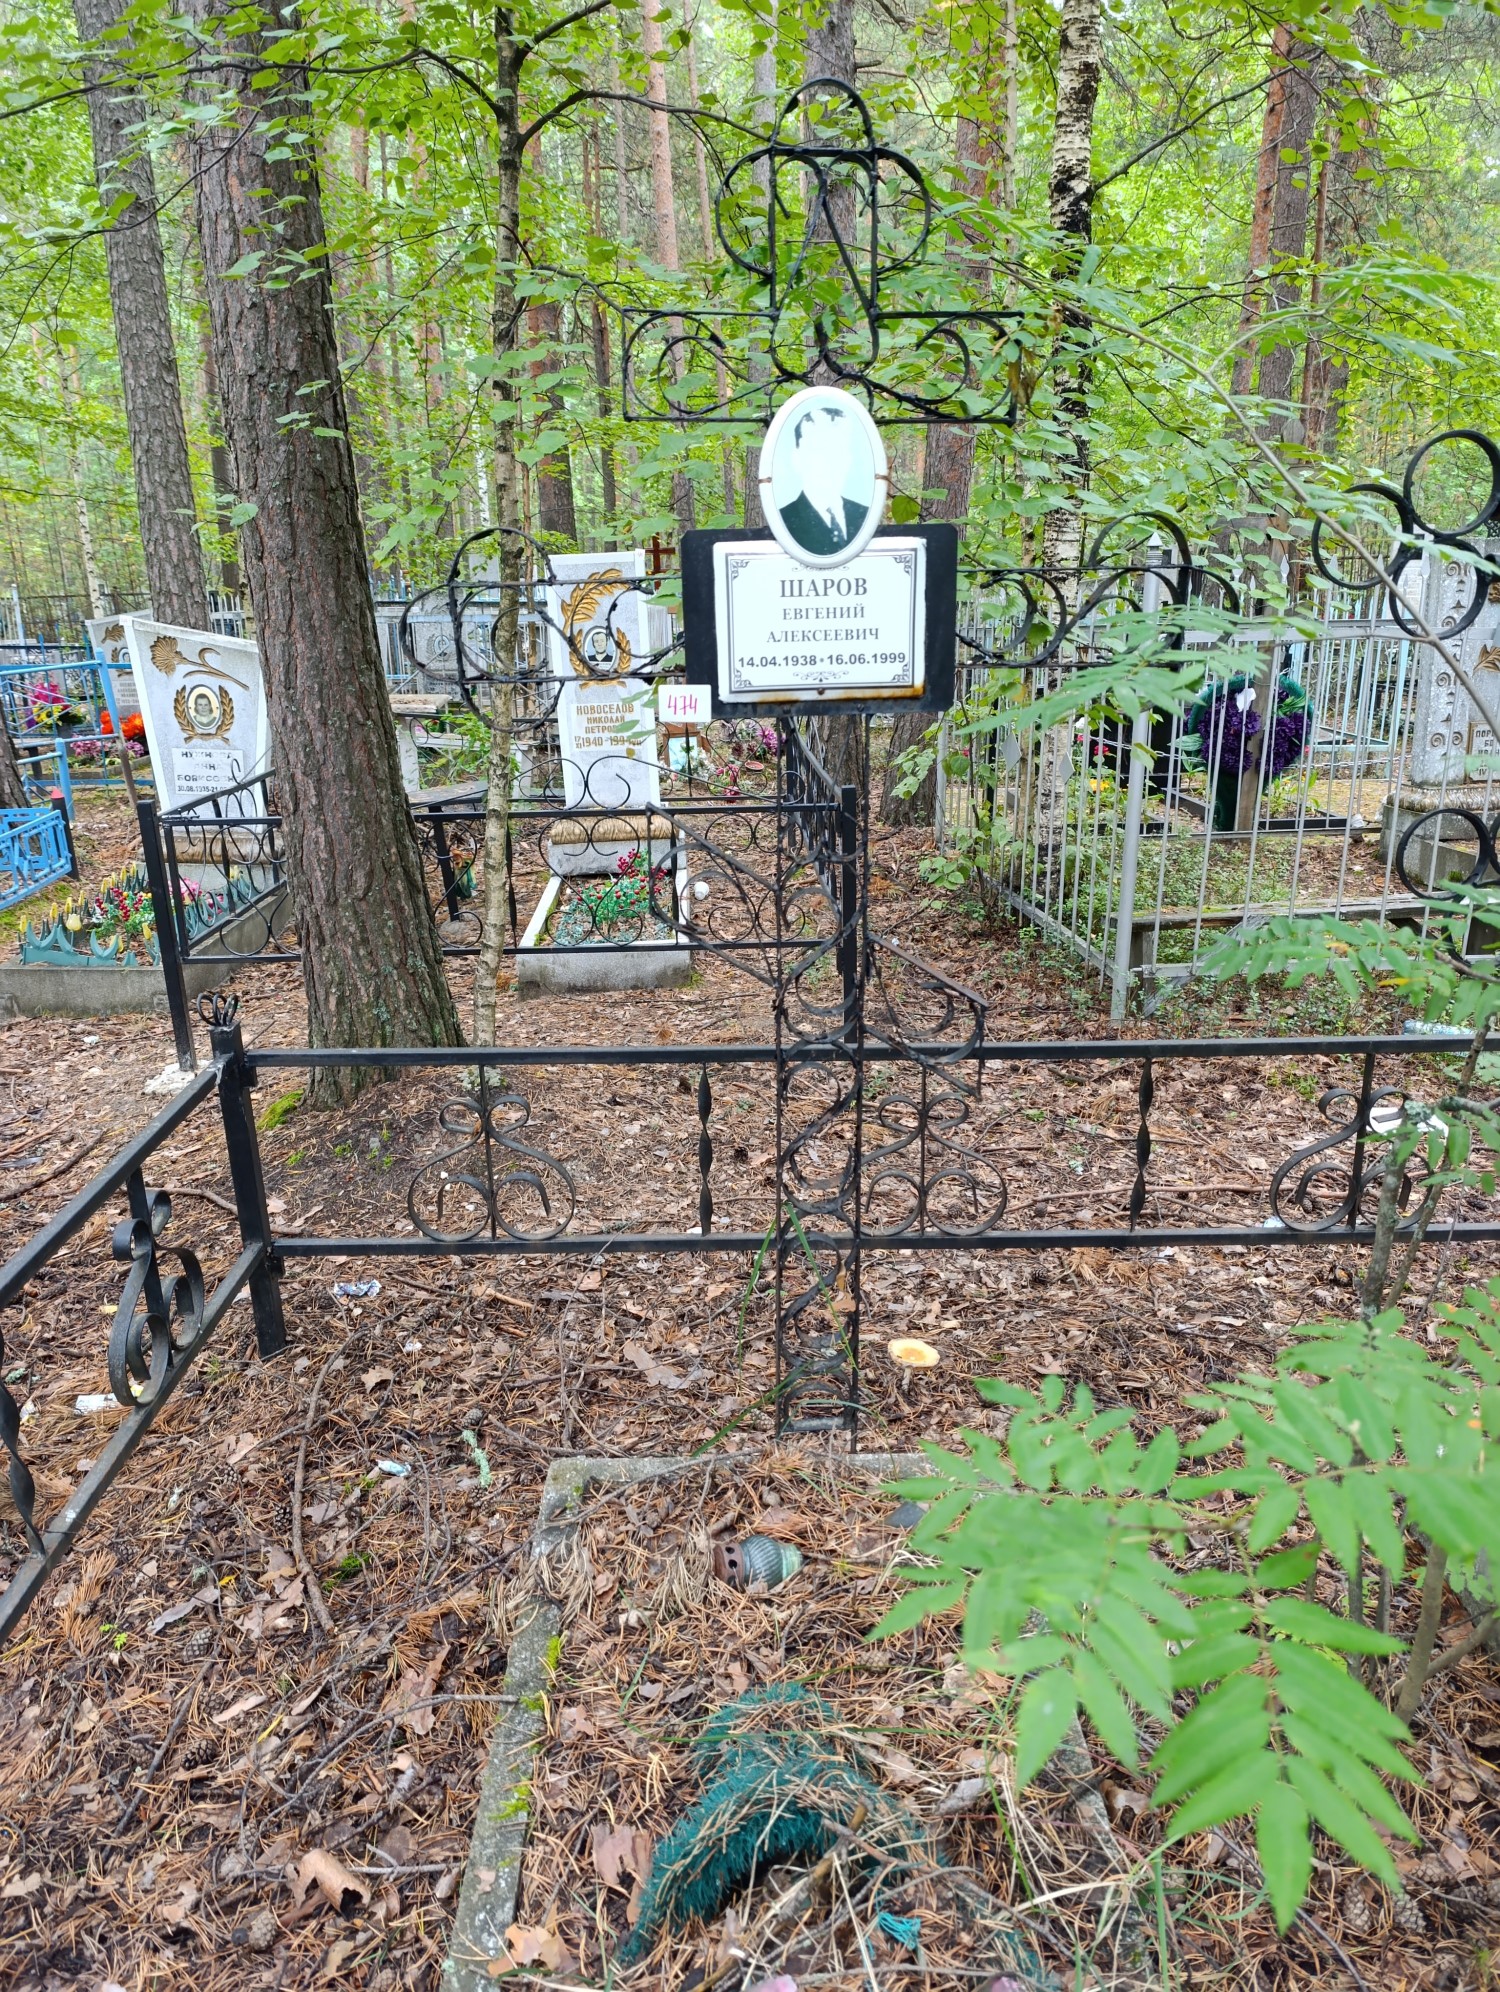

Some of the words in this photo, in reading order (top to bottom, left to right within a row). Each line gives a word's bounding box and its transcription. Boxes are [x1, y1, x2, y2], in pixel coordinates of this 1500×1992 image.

[779, 577, 868, 598] ШАРОВ
[782, 603, 866, 620] ЕВГЕНИЙ
[766, 627, 880, 643] АЛЕКСЕЕВИЧ
[738, 655, 817, 668] 14.04.1938
[827, 652, 906, 665] 16.06.1999
[576, 704, 635, 716] НОВОСЕЛОВ
[667, 694, 697, 716] 474
